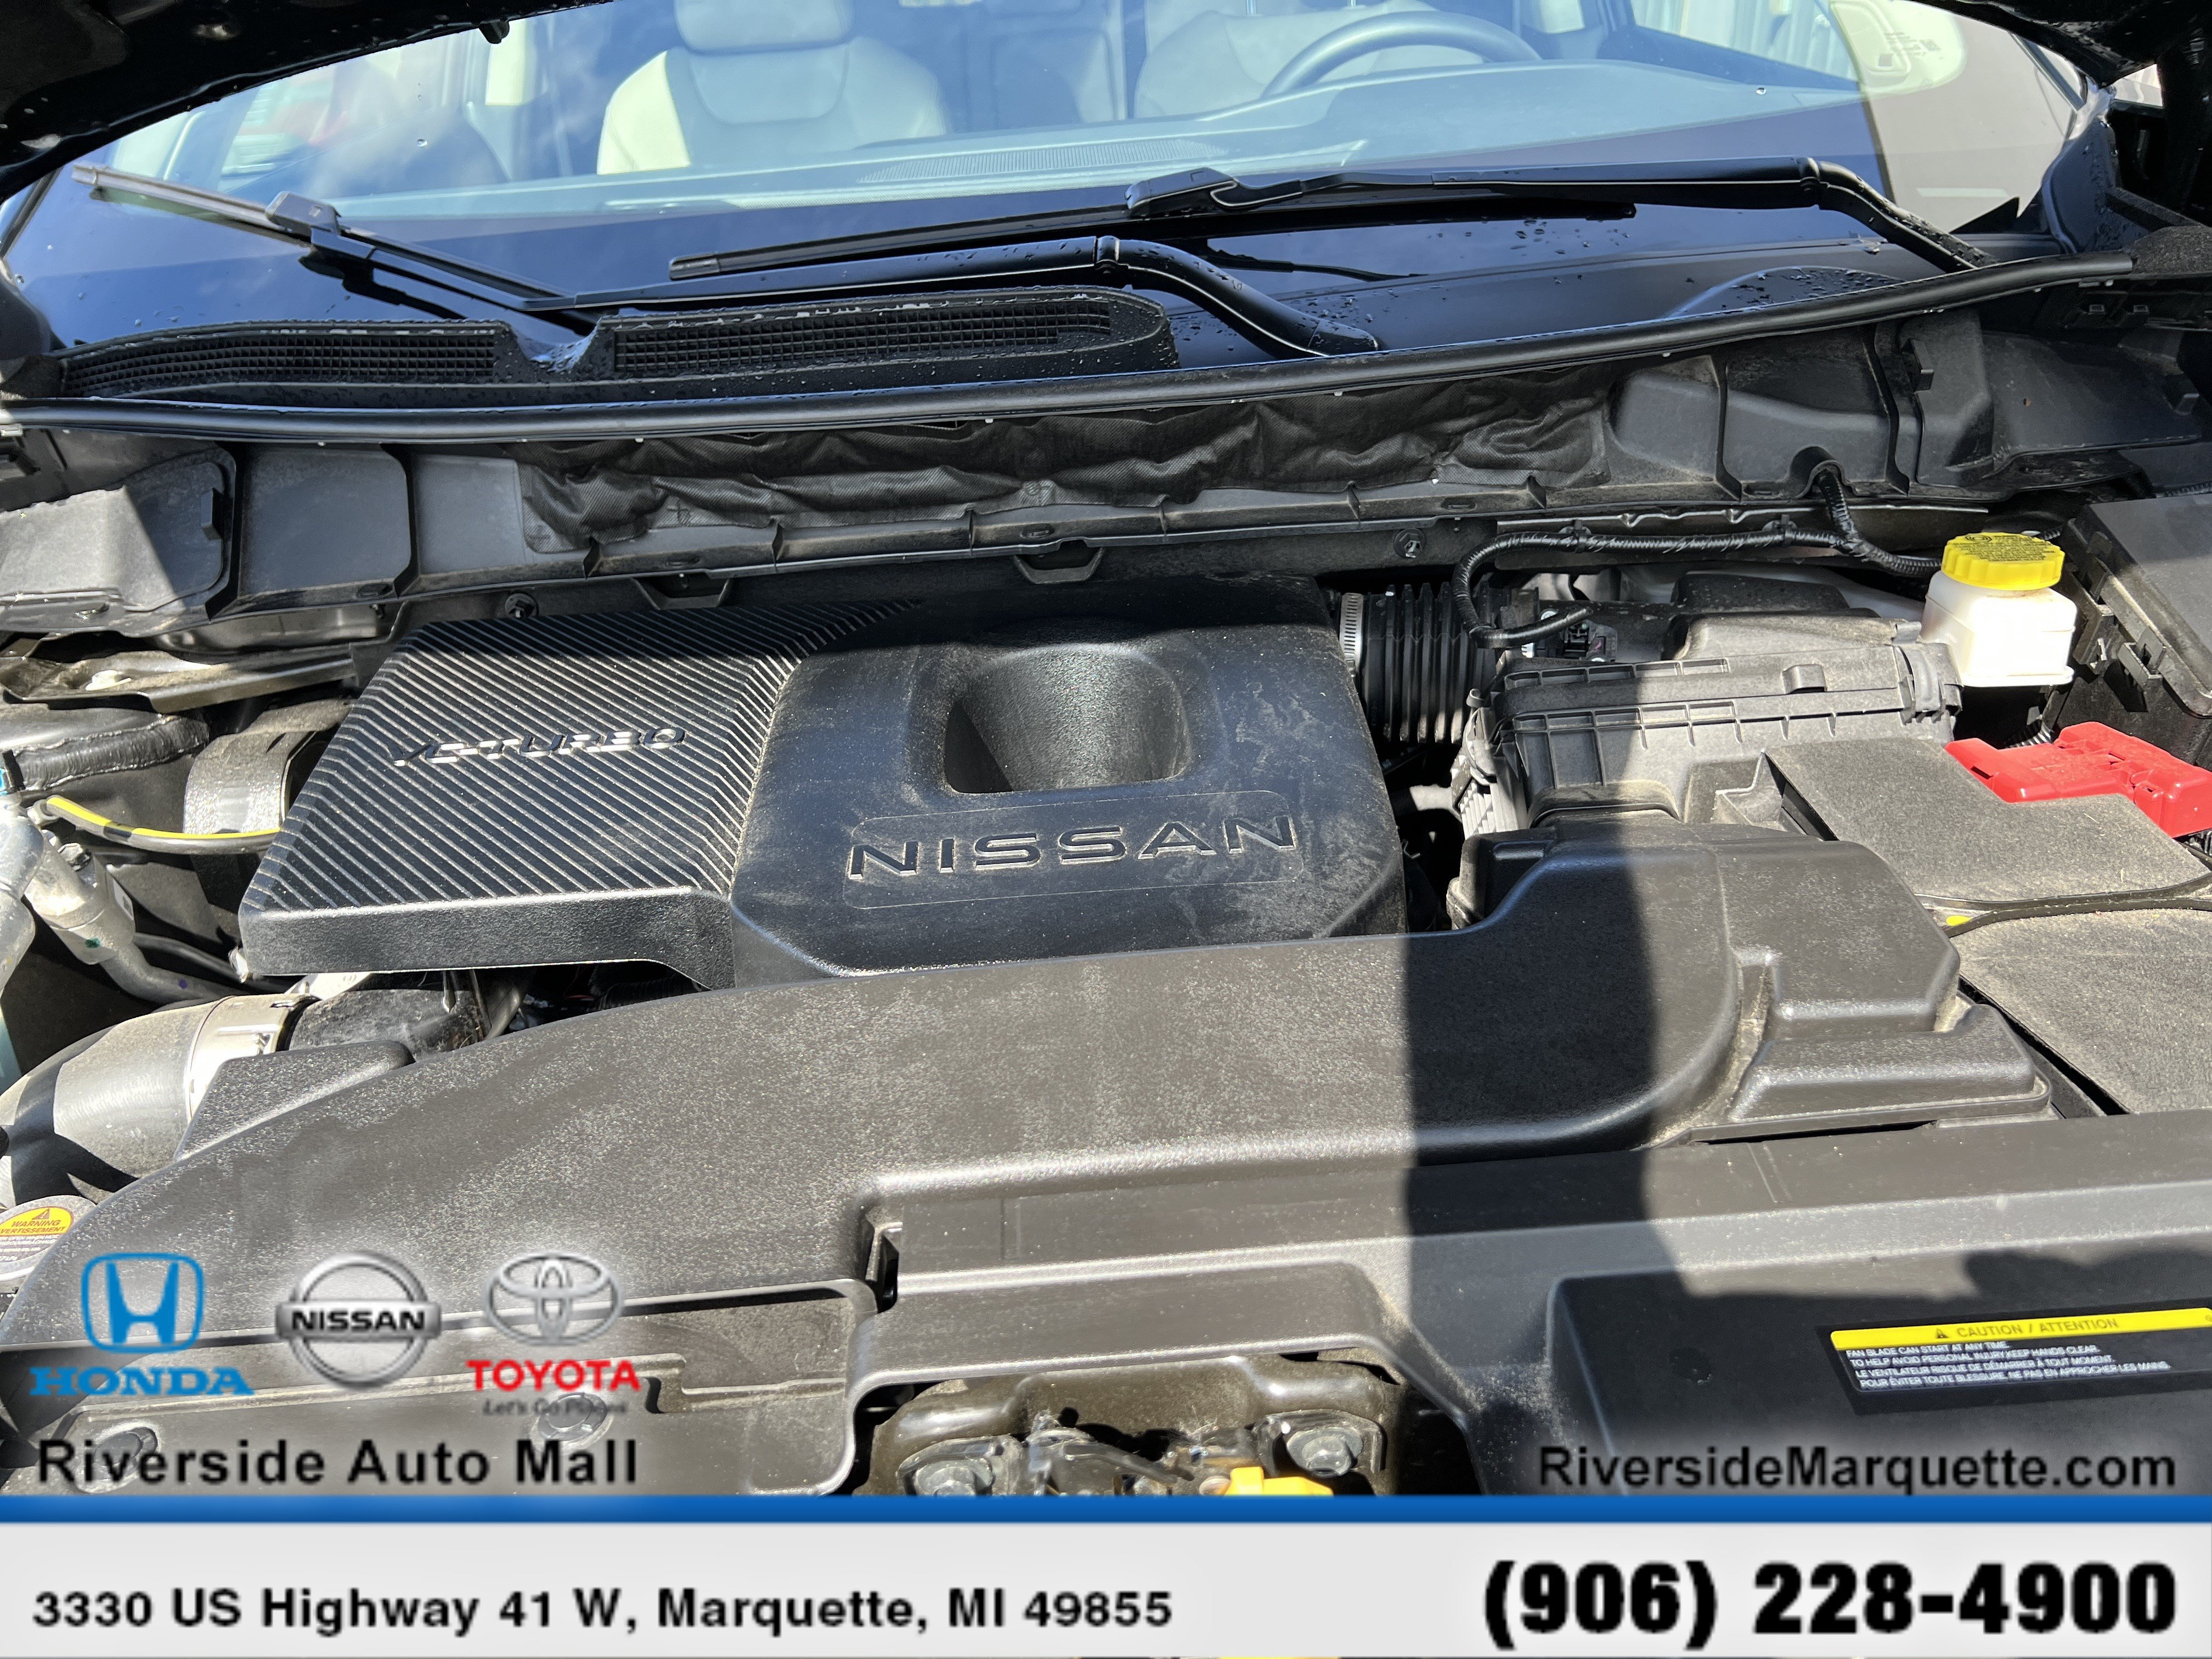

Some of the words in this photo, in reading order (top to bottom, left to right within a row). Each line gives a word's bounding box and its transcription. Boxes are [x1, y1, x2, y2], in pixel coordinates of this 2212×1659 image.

[849, 816, 1297, 880] NISSAN
[1957, 1323, 2024, 1338] CAUTION
[2040, 1318, 2119, 1333] ATTENTION
[1846, 1350, 1865, 1358] FAN
[1865, 1347, 1898, 1357] BLADE
[1898, 1346, 1920, 1355] CAN
[1920, 1345, 1949, 1353] START
[1951, 1344, 1962, 1352] AT
[1965, 1342, 1983, 1351] ANY
[1849, 1359, 1865, 1367] TO
[1865, 1357, 1891, 1366] HELP
[1892, 1356, 1920, 1365] AVOID
[1921, 1353, 1974, 1363] PERSONAL
[2031, 1346, 2066, 1357] HANDS
[1855, 1369, 1868, 1378] LE
[1868, 1366, 1930, 1377] VENTILATEUR
[1930, 1363, 1967, 1374] RISQUE
[1967, 1362, 1983, 1372] DE
[1983, 1359, 2036, 1371] DÉMARRER
[2044, 1358, 2069, 1367] TOUT
[1860, 1378, 1889, 1387] POUR
[1889, 1375, 1922, 1386] ÉVITER
[1922, 1374, 1955, 1384] TOUTE
[2008, 1370, 2023, 1379] NE
[2023, 1369, 2044, 1379] PAS
[2043, 1368, 2058, 1378] EN
[2118, 1363, 2137, 1372] LES
